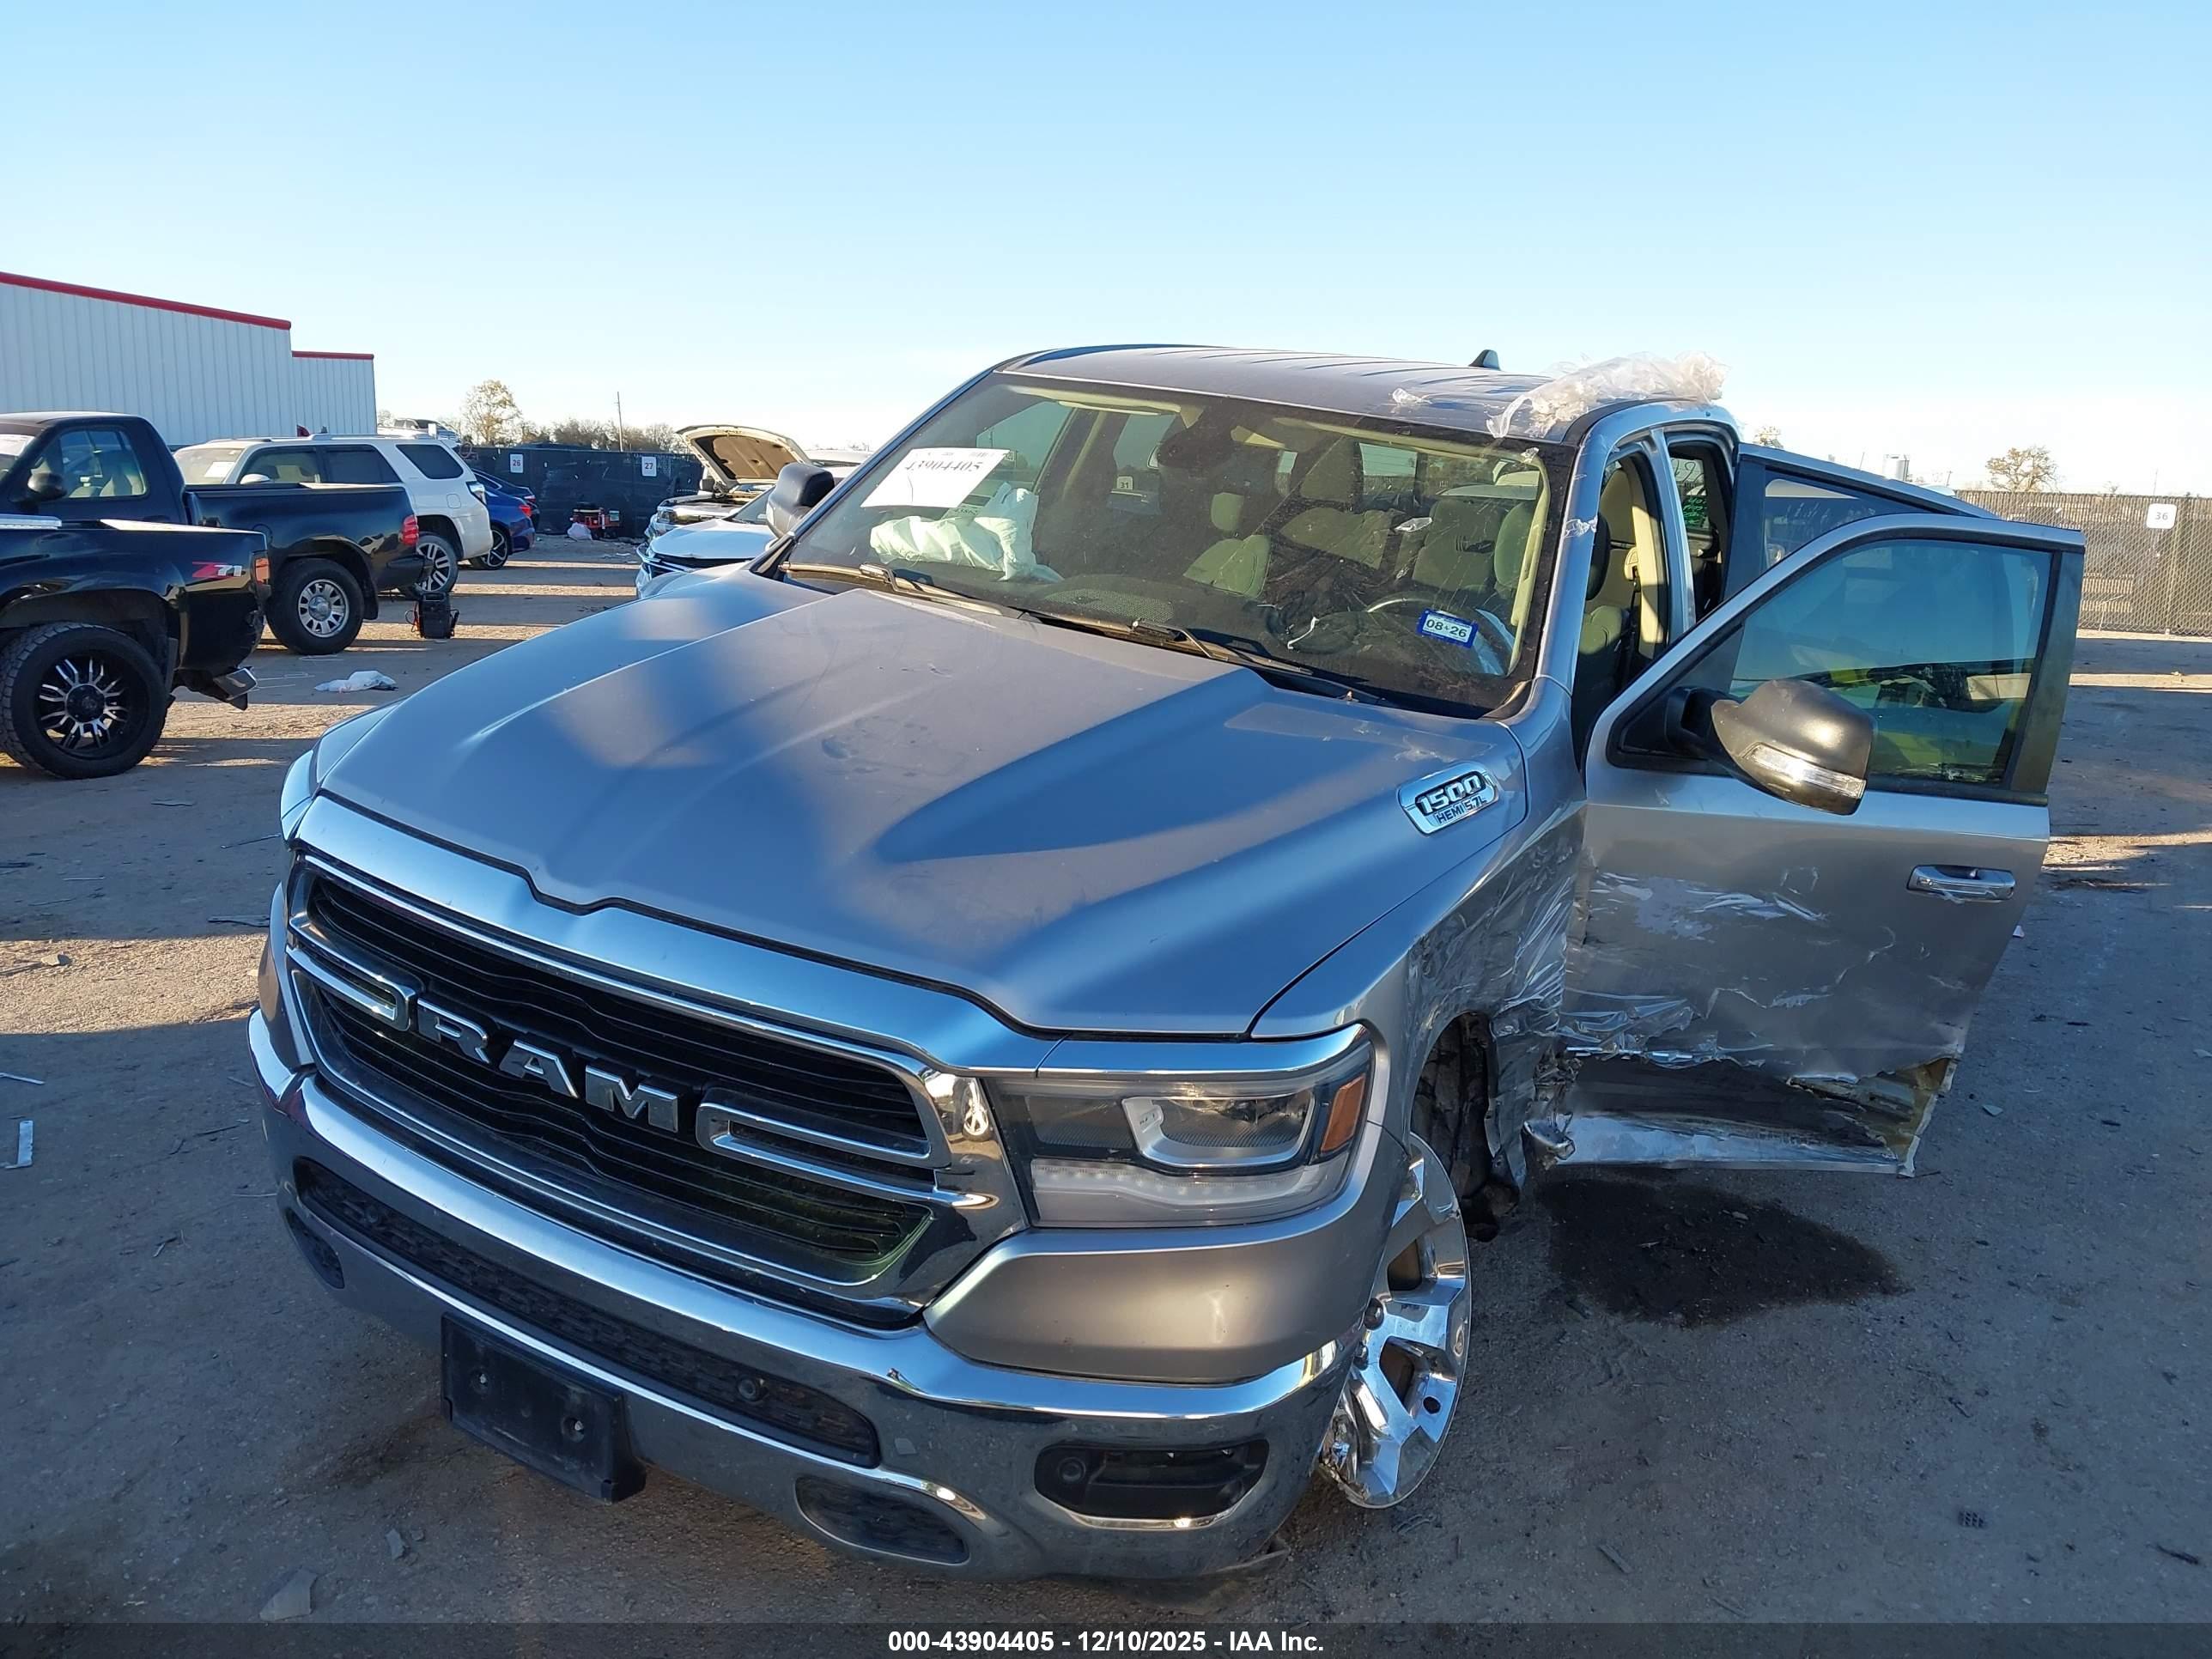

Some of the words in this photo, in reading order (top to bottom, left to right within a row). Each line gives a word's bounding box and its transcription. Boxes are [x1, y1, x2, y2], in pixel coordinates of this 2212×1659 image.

[512, 459, 521, 467] 26
[2154, 511, 2169, 521] 36
[192, 561, 243, 578] Z71
[1426, 619, 1443, 630] 08
[1449, 626, 1468, 637] 26
[1419, 775, 1482, 813] 1500
[1435, 802, 1465, 824] HEMI
[1465, 795, 1487, 811] 5.7L
[417, 999, 678, 1133] RAM
